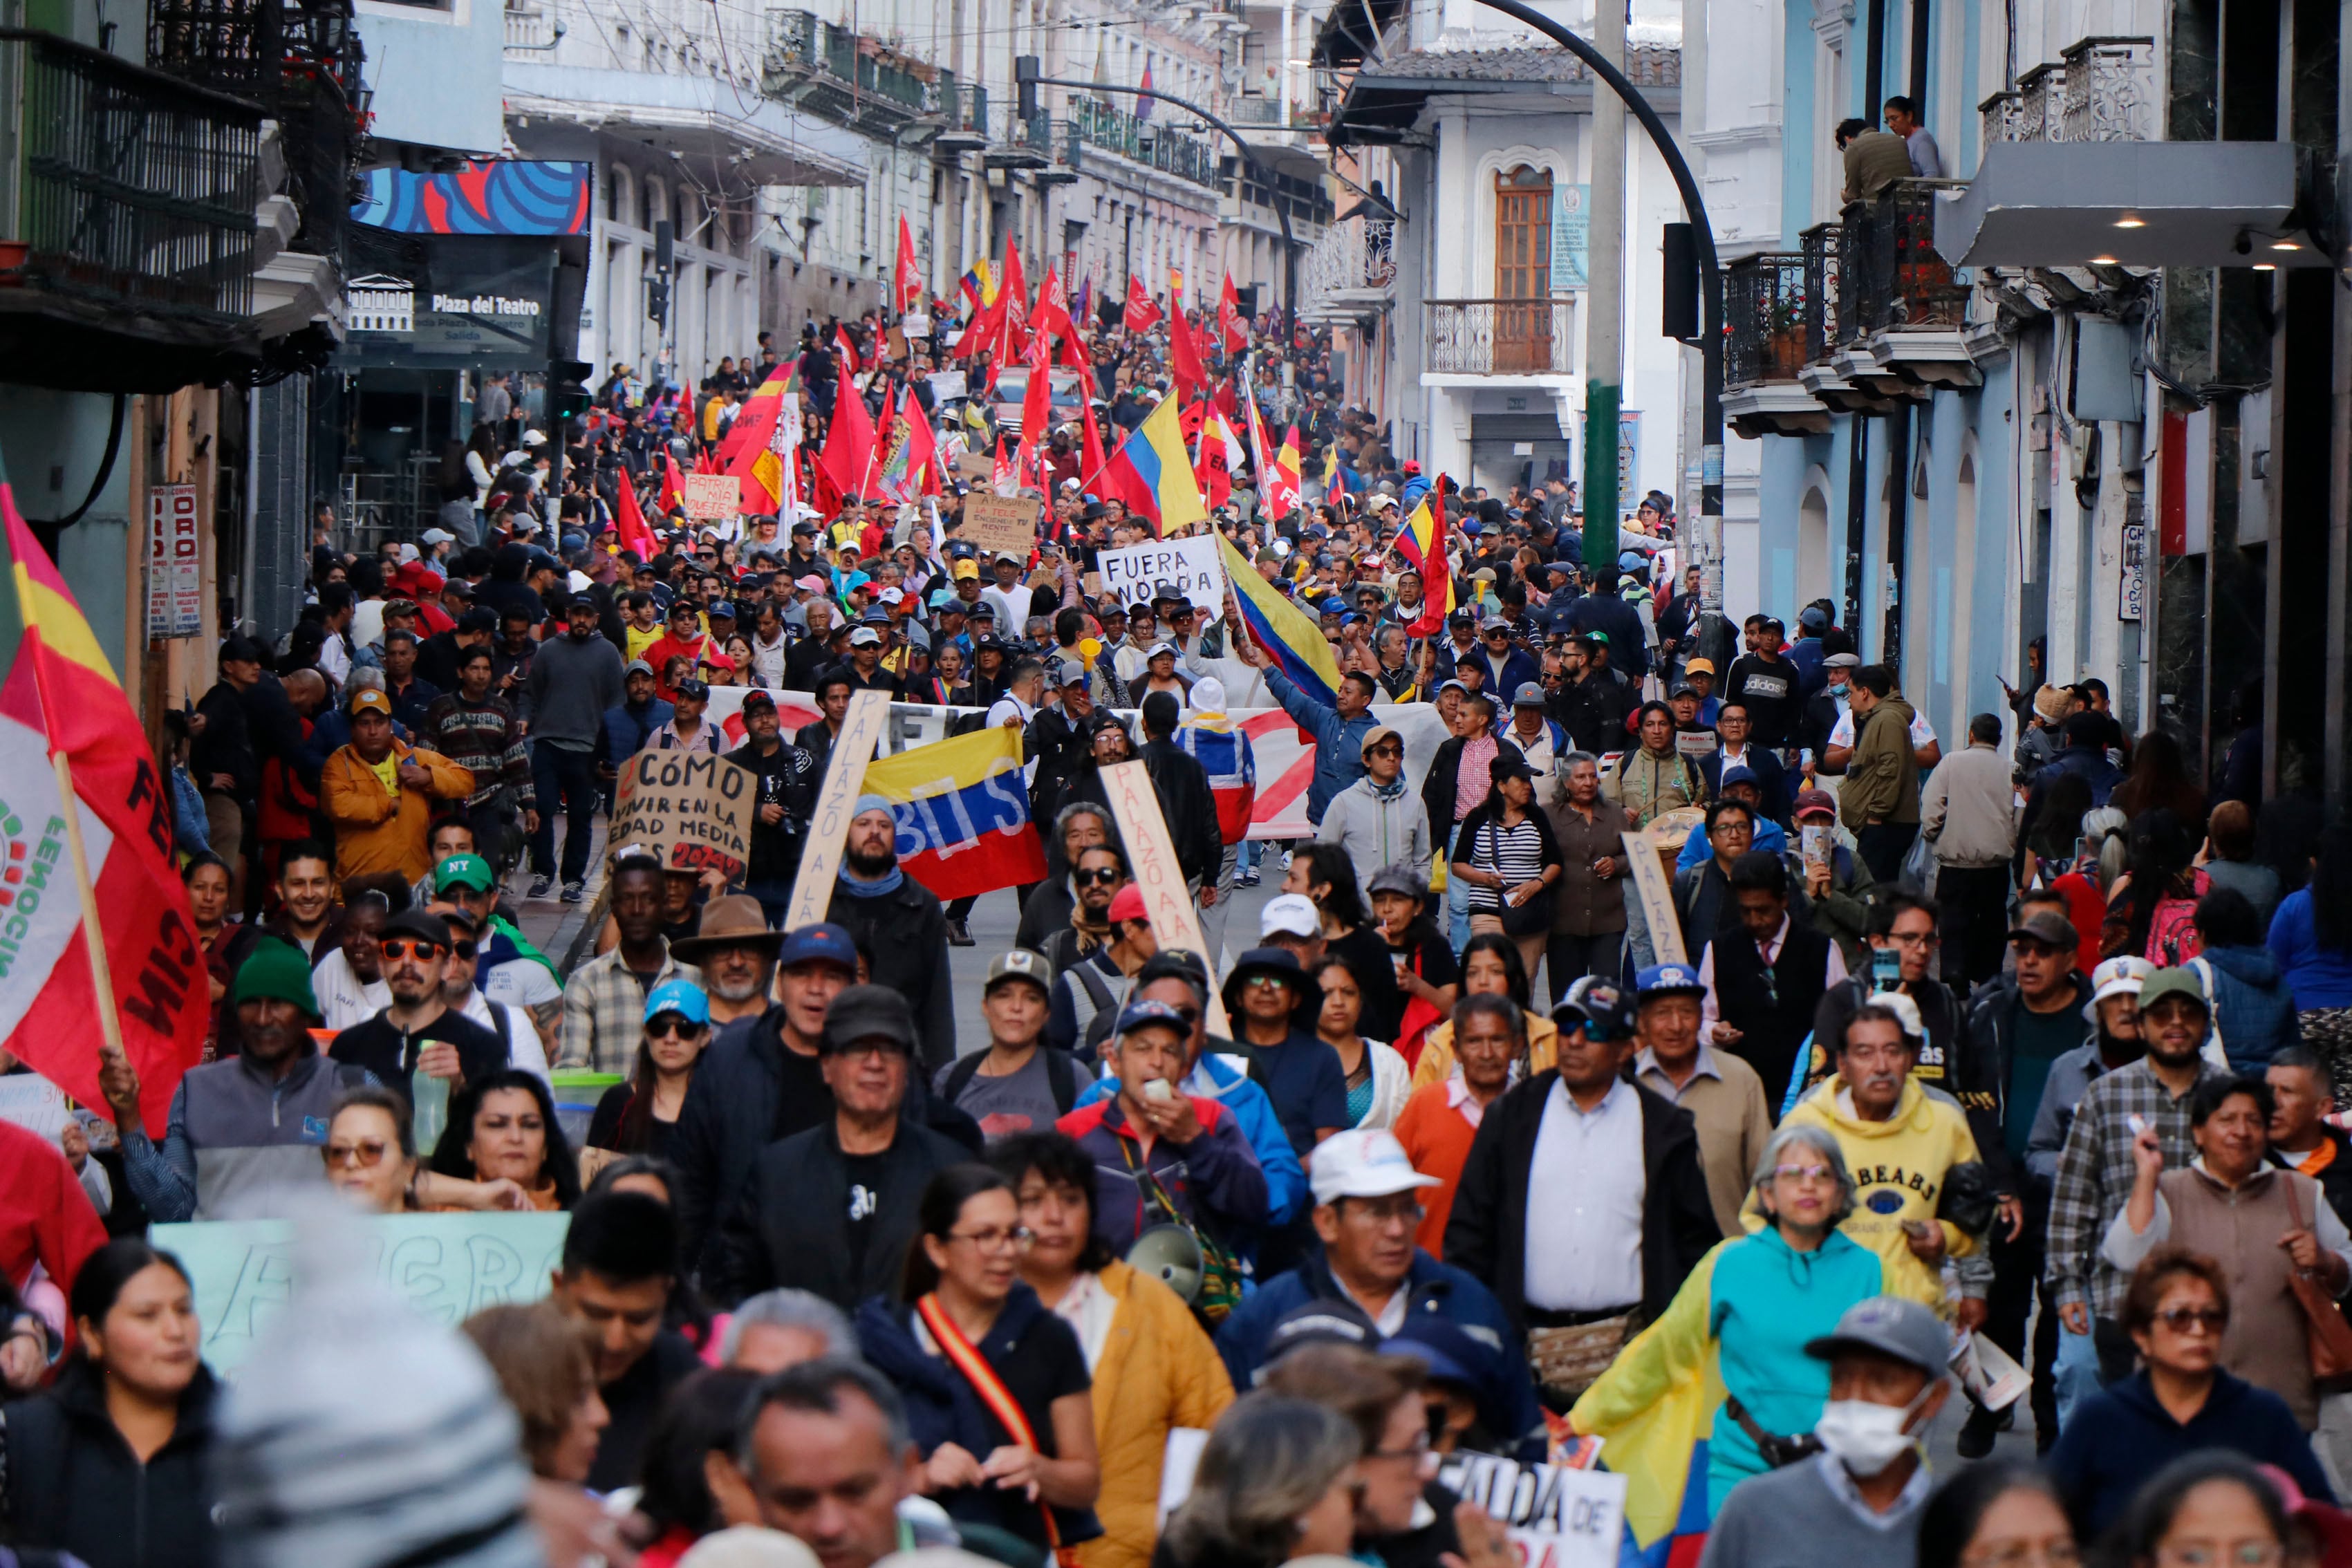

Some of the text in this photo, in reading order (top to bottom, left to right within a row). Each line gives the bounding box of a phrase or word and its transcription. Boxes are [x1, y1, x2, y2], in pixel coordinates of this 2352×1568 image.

[433, 295, 540, 315] Plaza del Teatro
[445, 330, 481, 341] Salida
[171, 487, 196, 496] COMPRO
[688, 477, 736, 492] PATRIA
[993, 508, 1018, 517] TELE
[174, 496, 196, 557] ORO
[1106, 551, 1188, 582] FUERA
[821, 693, 879, 837] PALAZO
[616, 796, 737, 830] VIVIR EN LA
[608, 818, 745, 854] EDAD MEDIA
[1114, 765, 1163, 886] PALAZO
[448, 861, 469, 872] NY
[811, 853, 823, 872] A
[798, 885, 814, 922] LA
[1160, 891, 1177, 912] A
